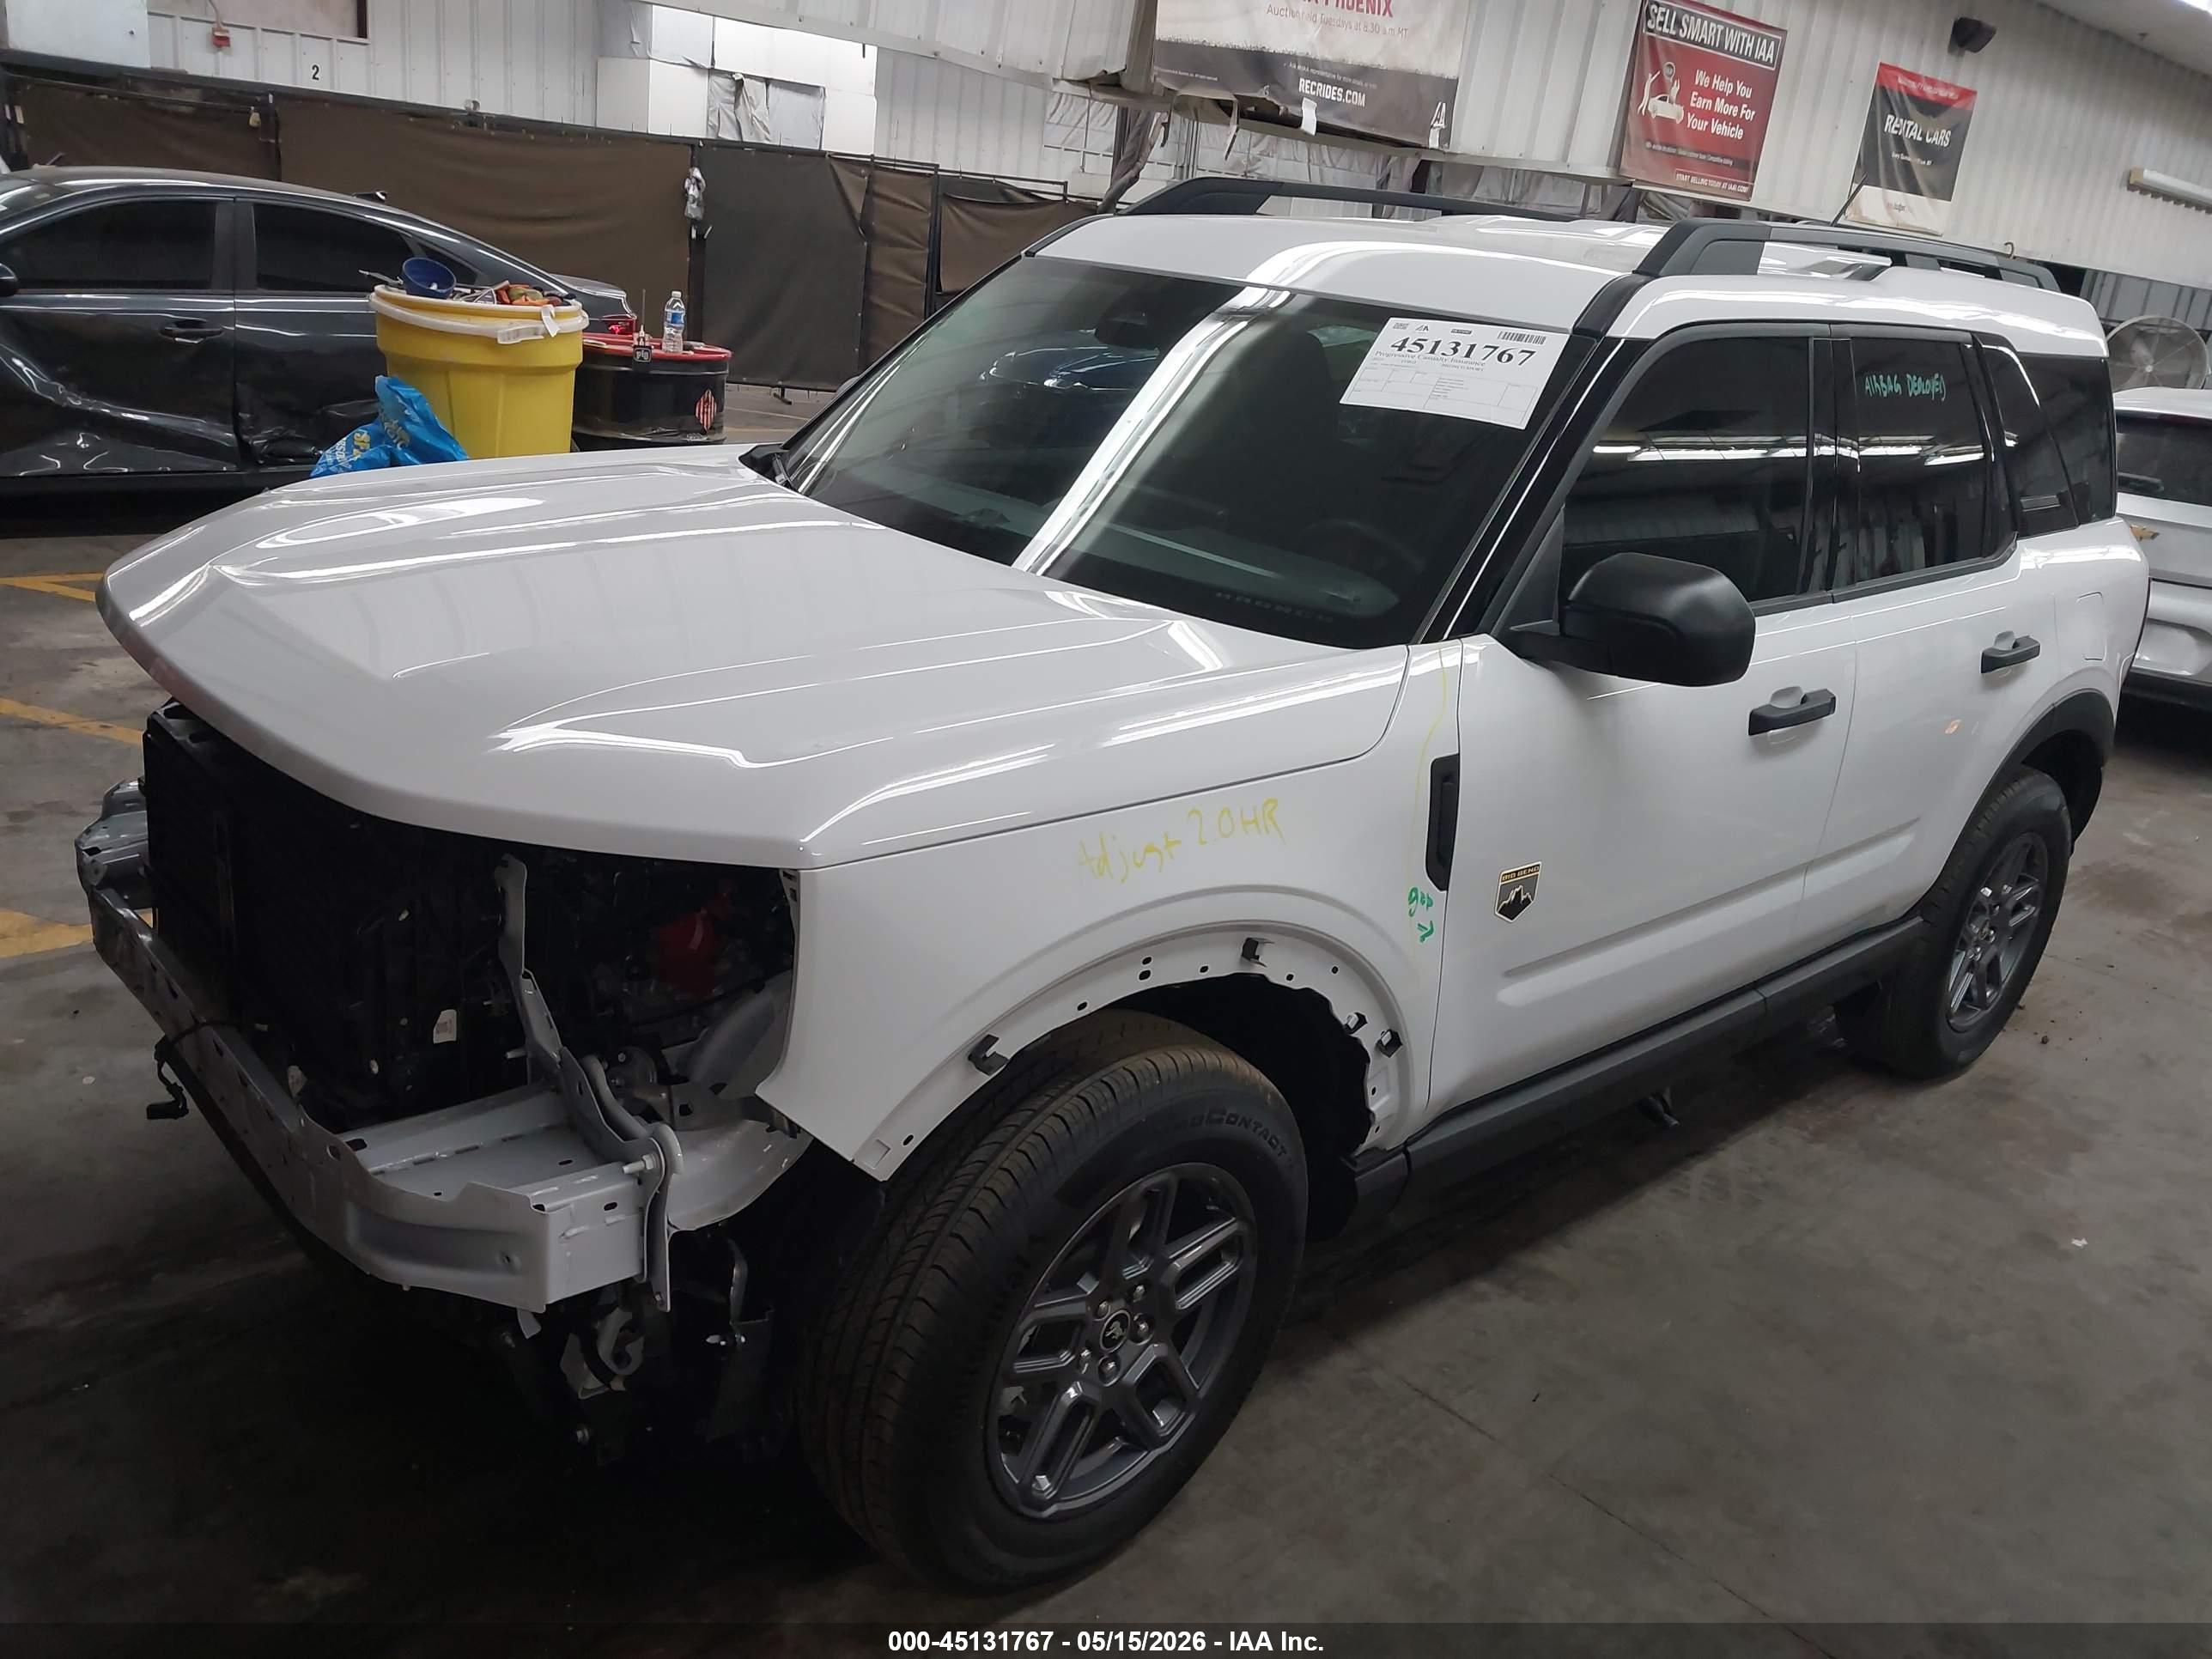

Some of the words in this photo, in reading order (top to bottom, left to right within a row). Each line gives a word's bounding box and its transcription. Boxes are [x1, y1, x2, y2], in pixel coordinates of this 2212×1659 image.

[1647, 3, 1677, 35] SELL
[1680, 14, 1723, 47] SMART
[1724, 27, 1756, 58] WITH
[1754, 36, 1775, 64] IAA
[312, 64, 320, 81] 2
[1695, 69, 1710, 88] We
[1711, 74, 1734, 96] Help
[1736, 80, 1752, 98] You
[1299, 77, 1366, 107] RECRIDES.COM
[1690, 91, 1712, 111] Earn
[1714, 97, 1738, 117] More
[1739, 104, 1756, 121] For
[1687, 112, 1709, 131] Your
[1711, 118, 1744, 140] Vehicle
[1884, 114, 1923, 142] RENTAL
[1925, 129, 1952, 147] CARS
[1375, 350, 1416, 359] Progressive
[1450, 357, 1486, 367] Insurance
[1390, 336, 1536, 367] 45131767
[1516, 865, 1540, 877] BEND
